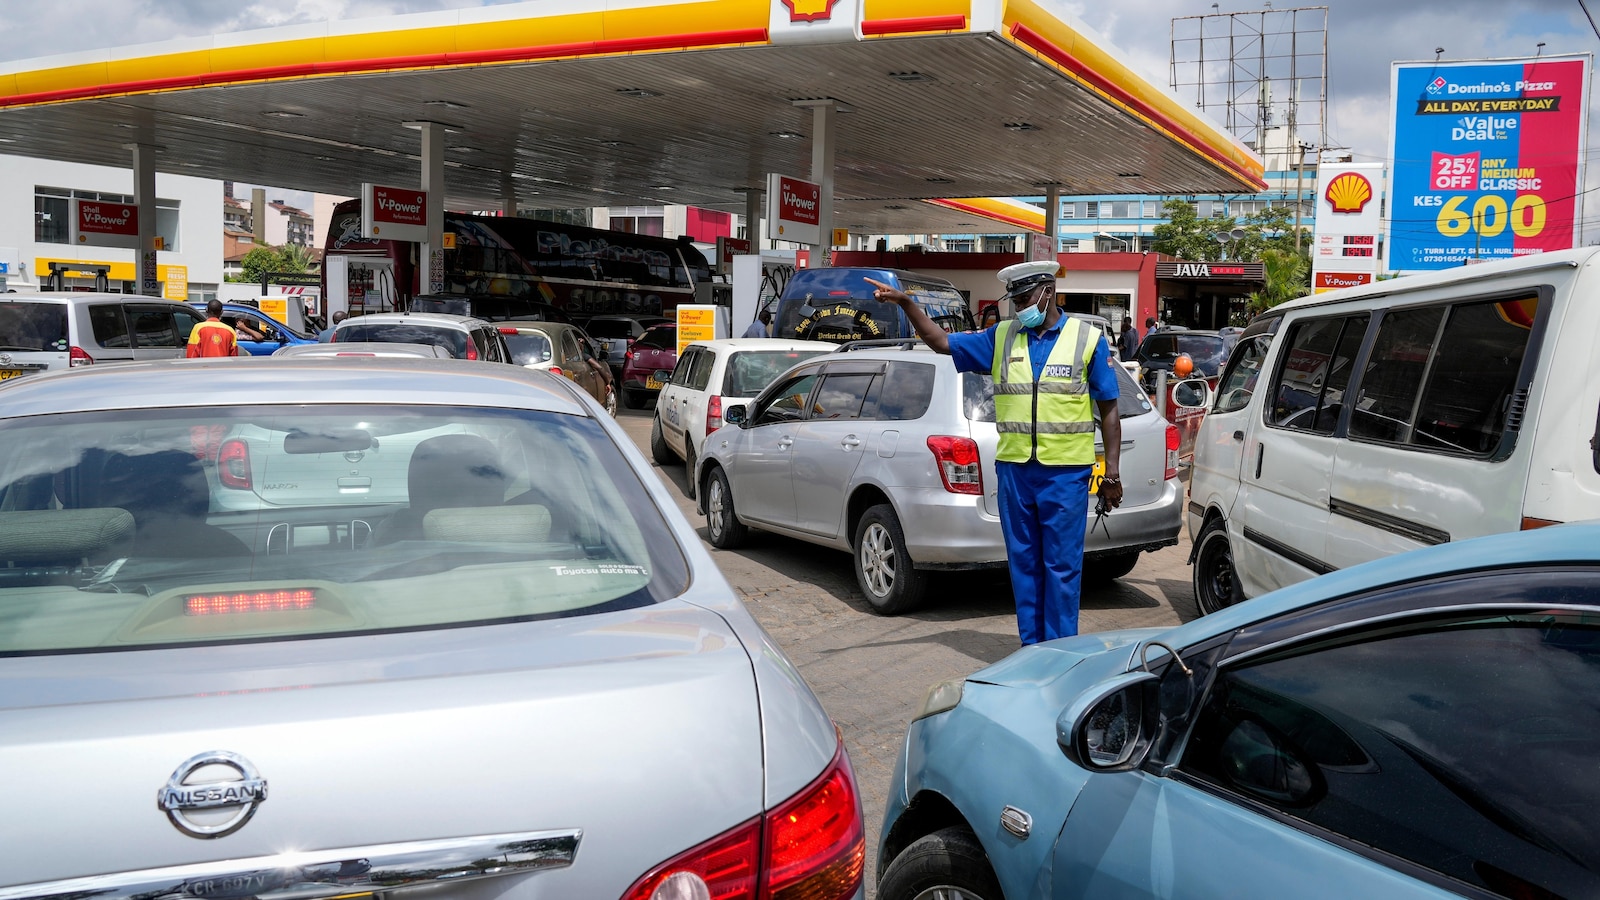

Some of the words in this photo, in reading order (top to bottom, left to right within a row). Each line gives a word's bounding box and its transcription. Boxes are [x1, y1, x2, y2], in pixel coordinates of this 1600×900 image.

[1447, 81, 1511, 94] Domino's
[1515, 80, 1553, 91] Pizza
[1424, 102, 1449, 112] ALL
[1451, 101, 1480, 112] DAY,
[1482, 99, 1554, 111] EVERYDAY
[1464, 116, 1517, 130] Value
[1451, 127, 1496, 141] Deal
[1437, 158, 1476, 175] 25%
[1481, 159, 1507, 168] ANY
[1481, 168, 1535, 179] MEDIUM
[1436, 176, 1472, 188] OFF
[1480, 178, 1542, 191] CLASSIC
[378, 198, 421, 214] V-Power
[783, 191, 816, 211] V-Power
[1413, 195, 1443, 206] KES
[83, 213, 127, 226] V-Power
[1436, 194, 1547, 237] 600
[445, 237, 451, 245] 7
[837, 231, 842, 241] 1
[1172, 263, 1210, 277] JAVA
[1325, 278, 1361, 287] V-Power
[1046, 366, 1071, 377] POLICE
[549, 566, 598, 576] Toyotsu
[169, 786, 255, 804] NISSAN
